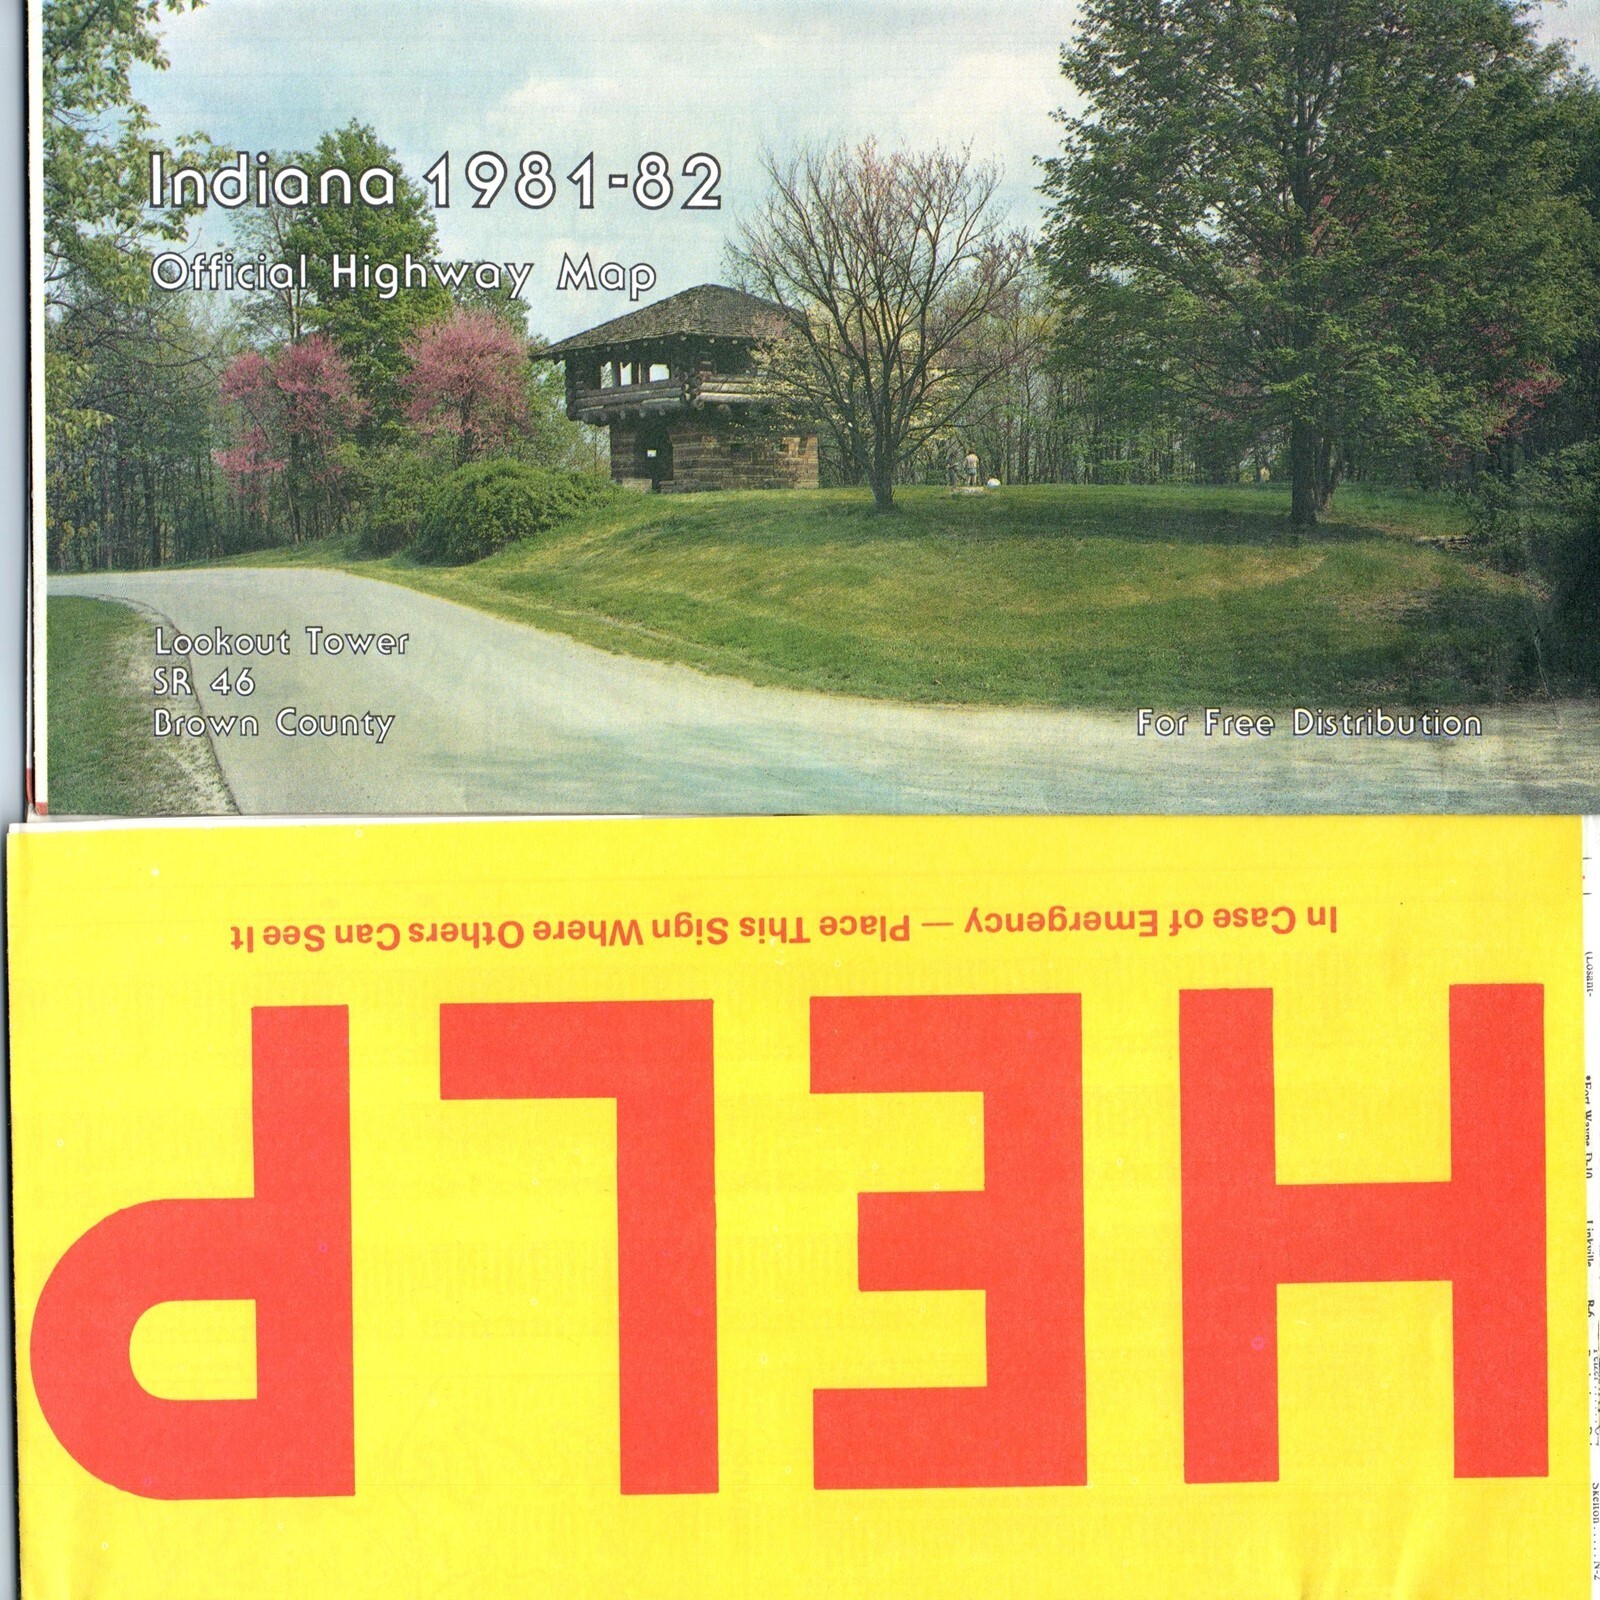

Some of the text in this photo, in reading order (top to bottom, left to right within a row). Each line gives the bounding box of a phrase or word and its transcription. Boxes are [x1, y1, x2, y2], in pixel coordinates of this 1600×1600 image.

[149, 151, 723, 210] Indiana 1981-82
[151, 252, 657, 301] Official Highway Map
[154, 626, 410, 656] Lookout Tower
[153, 667, 256, 696] SR 46
[154, 707, 396, 744] Brown County
[1137, 707, 1483, 737] For Free Distribution
[533, 919, 644, 947] Where
[652, 911, 729, 945] Sign
[739, 917, 811, 944] This
[819, 915, 910, 942] Place
[964, 905, 1158, 937] Emergency
[1169, 909, 1204, 937] of
[1213, 906, 1296, 935] Case
[1307, 906, 1337, 933] In
[230, 926, 254, 953] It
[263, 924, 325, 952] See
[335, 923, 401, 951] Can
[408, 920, 525, 949] Others
[30, 983, 1549, 1501] HELP
